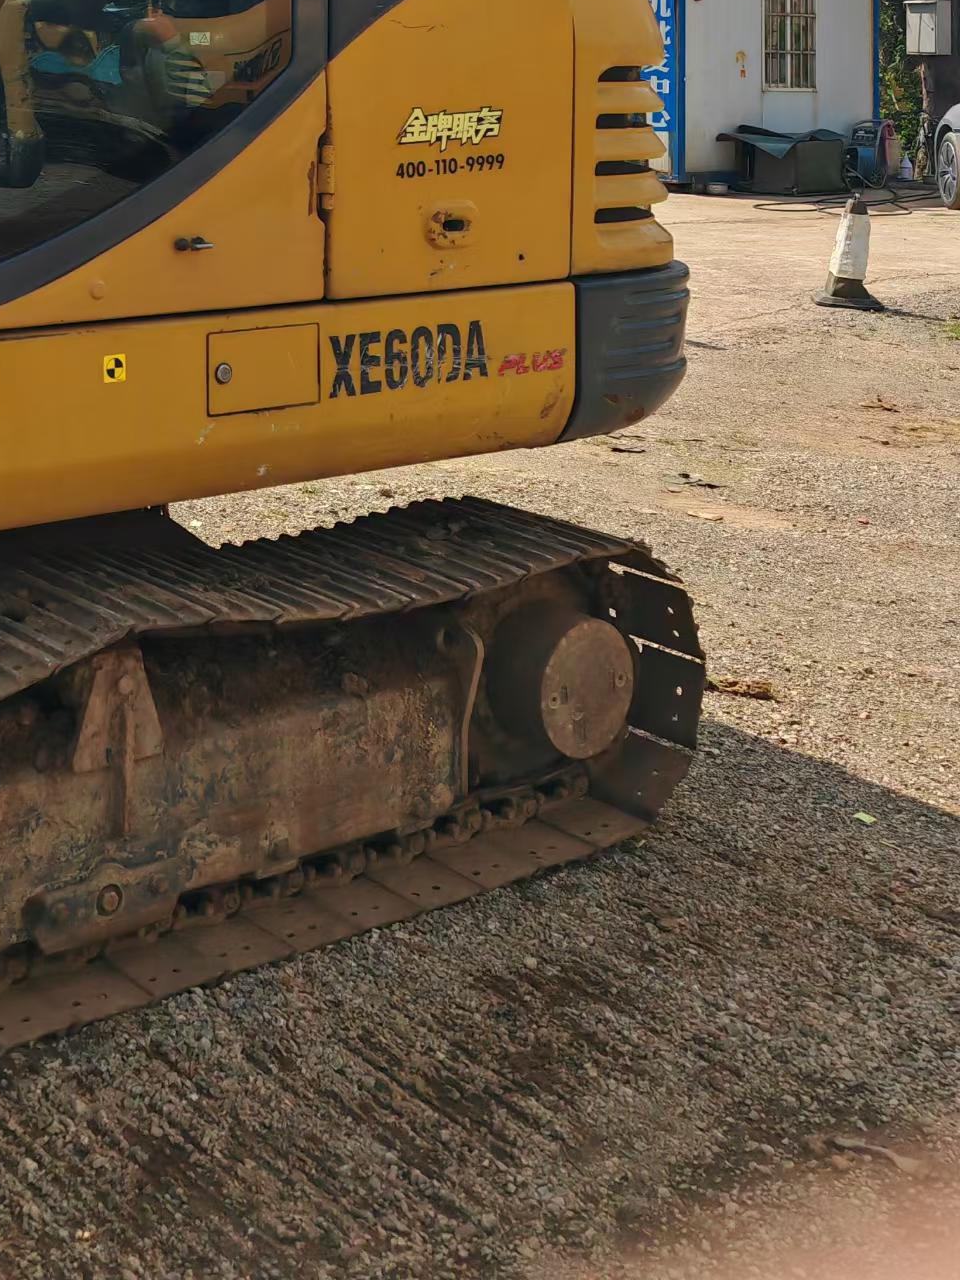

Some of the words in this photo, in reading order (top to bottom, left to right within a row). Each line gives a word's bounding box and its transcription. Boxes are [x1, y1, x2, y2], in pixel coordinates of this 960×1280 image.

[397, 106, 503, 152] 金牌服务
[396, 154, 505, 179] 400-110-9999
[329, 320, 488, 399] XE60DA
